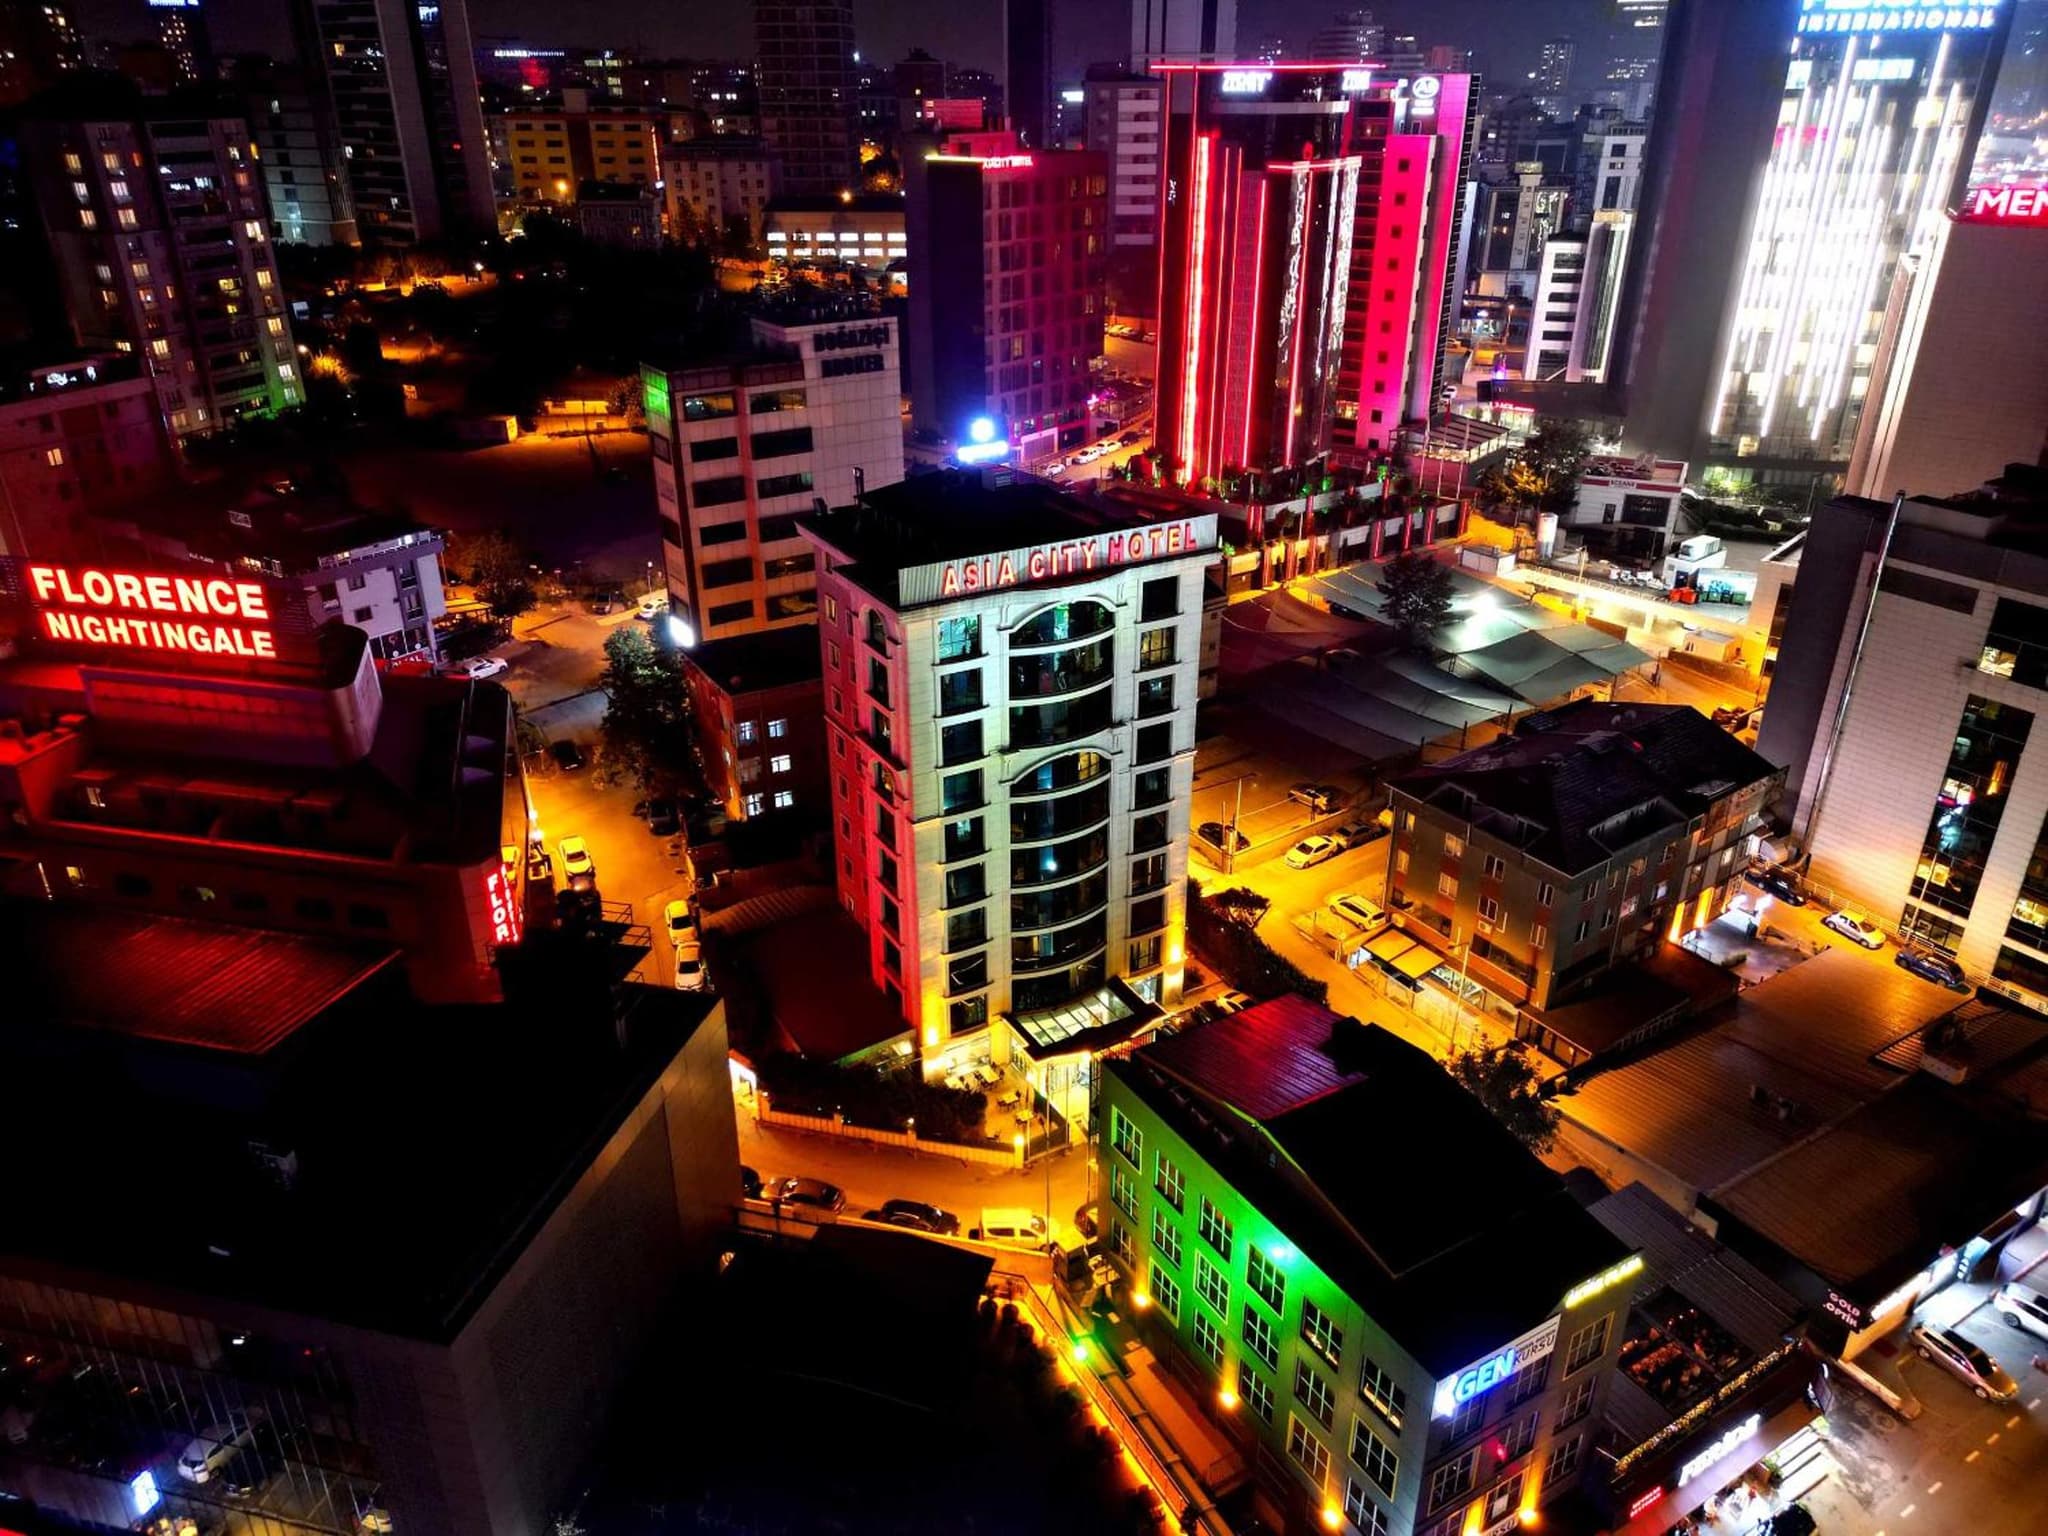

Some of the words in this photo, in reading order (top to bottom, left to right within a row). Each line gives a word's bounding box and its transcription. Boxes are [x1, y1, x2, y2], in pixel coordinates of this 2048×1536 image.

[1797, 8, 1995, 32] INTERNATIONAL
[942, 554, 1017, 596] ASIA
[1028, 539, 1097, 579] CITY
[1107, 521, 1198, 565] HOTEL
[31, 567, 268, 619] FLORENCE
[46, 612, 276, 658] NIGHTINGALE
[1829, 1292, 1861, 1317] GOLD
[1454, 1348, 1515, 1402] GEN
[1513, 1333, 1555, 1366] KURSU
